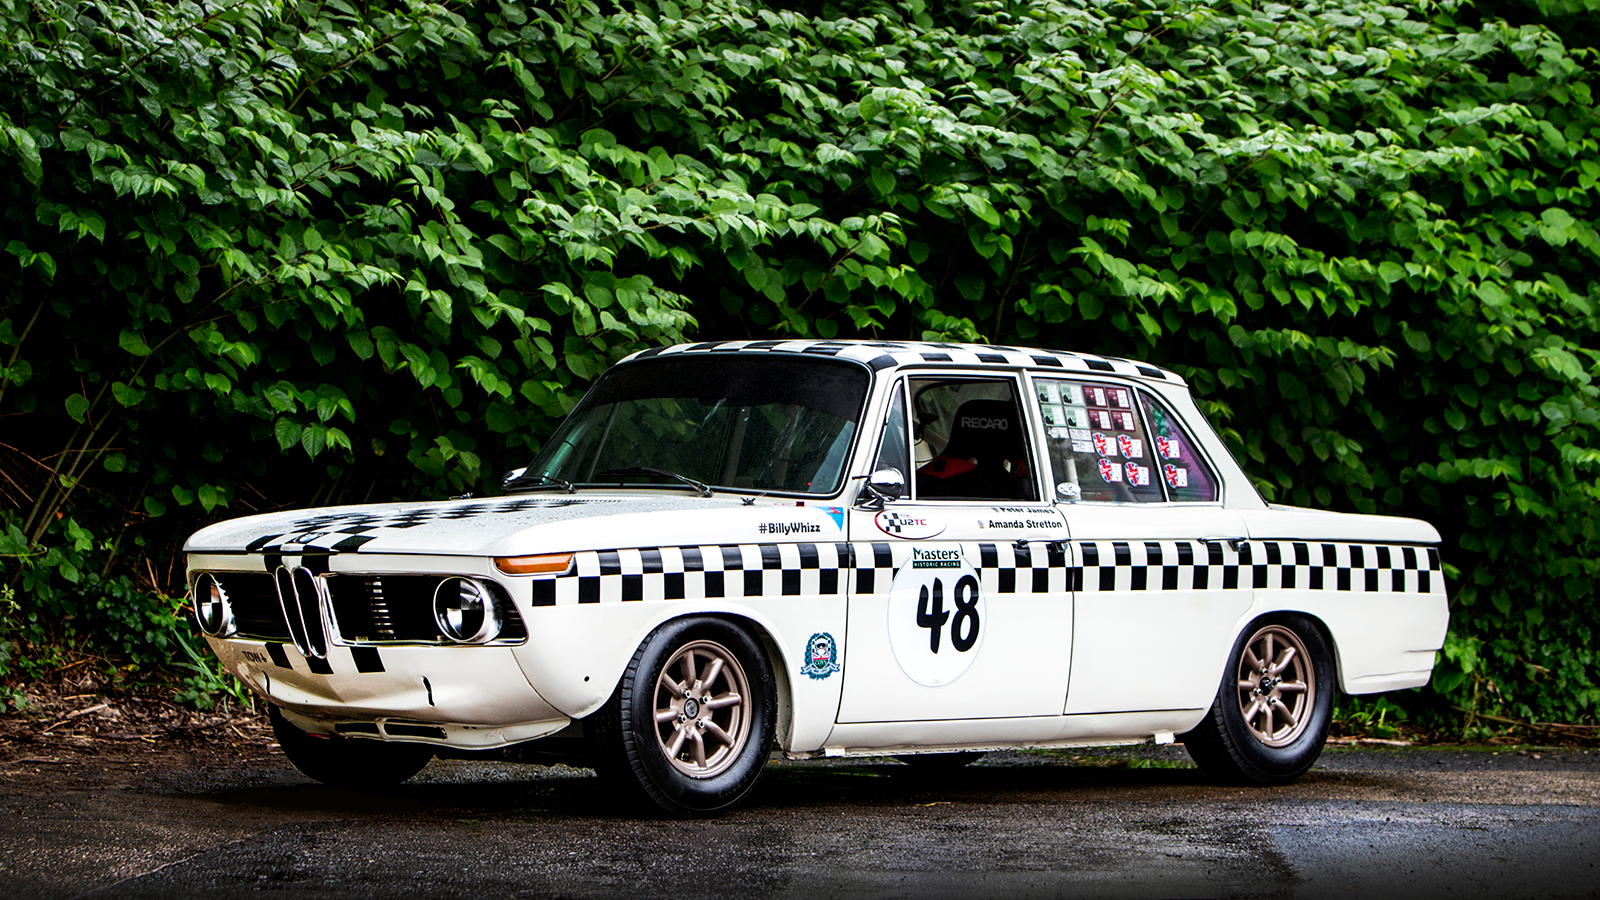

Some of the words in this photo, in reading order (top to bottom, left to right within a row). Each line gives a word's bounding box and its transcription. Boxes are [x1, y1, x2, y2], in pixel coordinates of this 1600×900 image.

[961, 417, 1008, 430] RECARO
[899, 518, 927, 526] U2TC
[988, 520, 1024, 529] Amanda
[1026, 519, 1063, 529] Stretton
[758, 522, 821, 536] #BillyWhizz
[912, 546, 960, 560] Masters
[916, 574, 980, 655] 48
[242, 651, 262, 663] TOW
